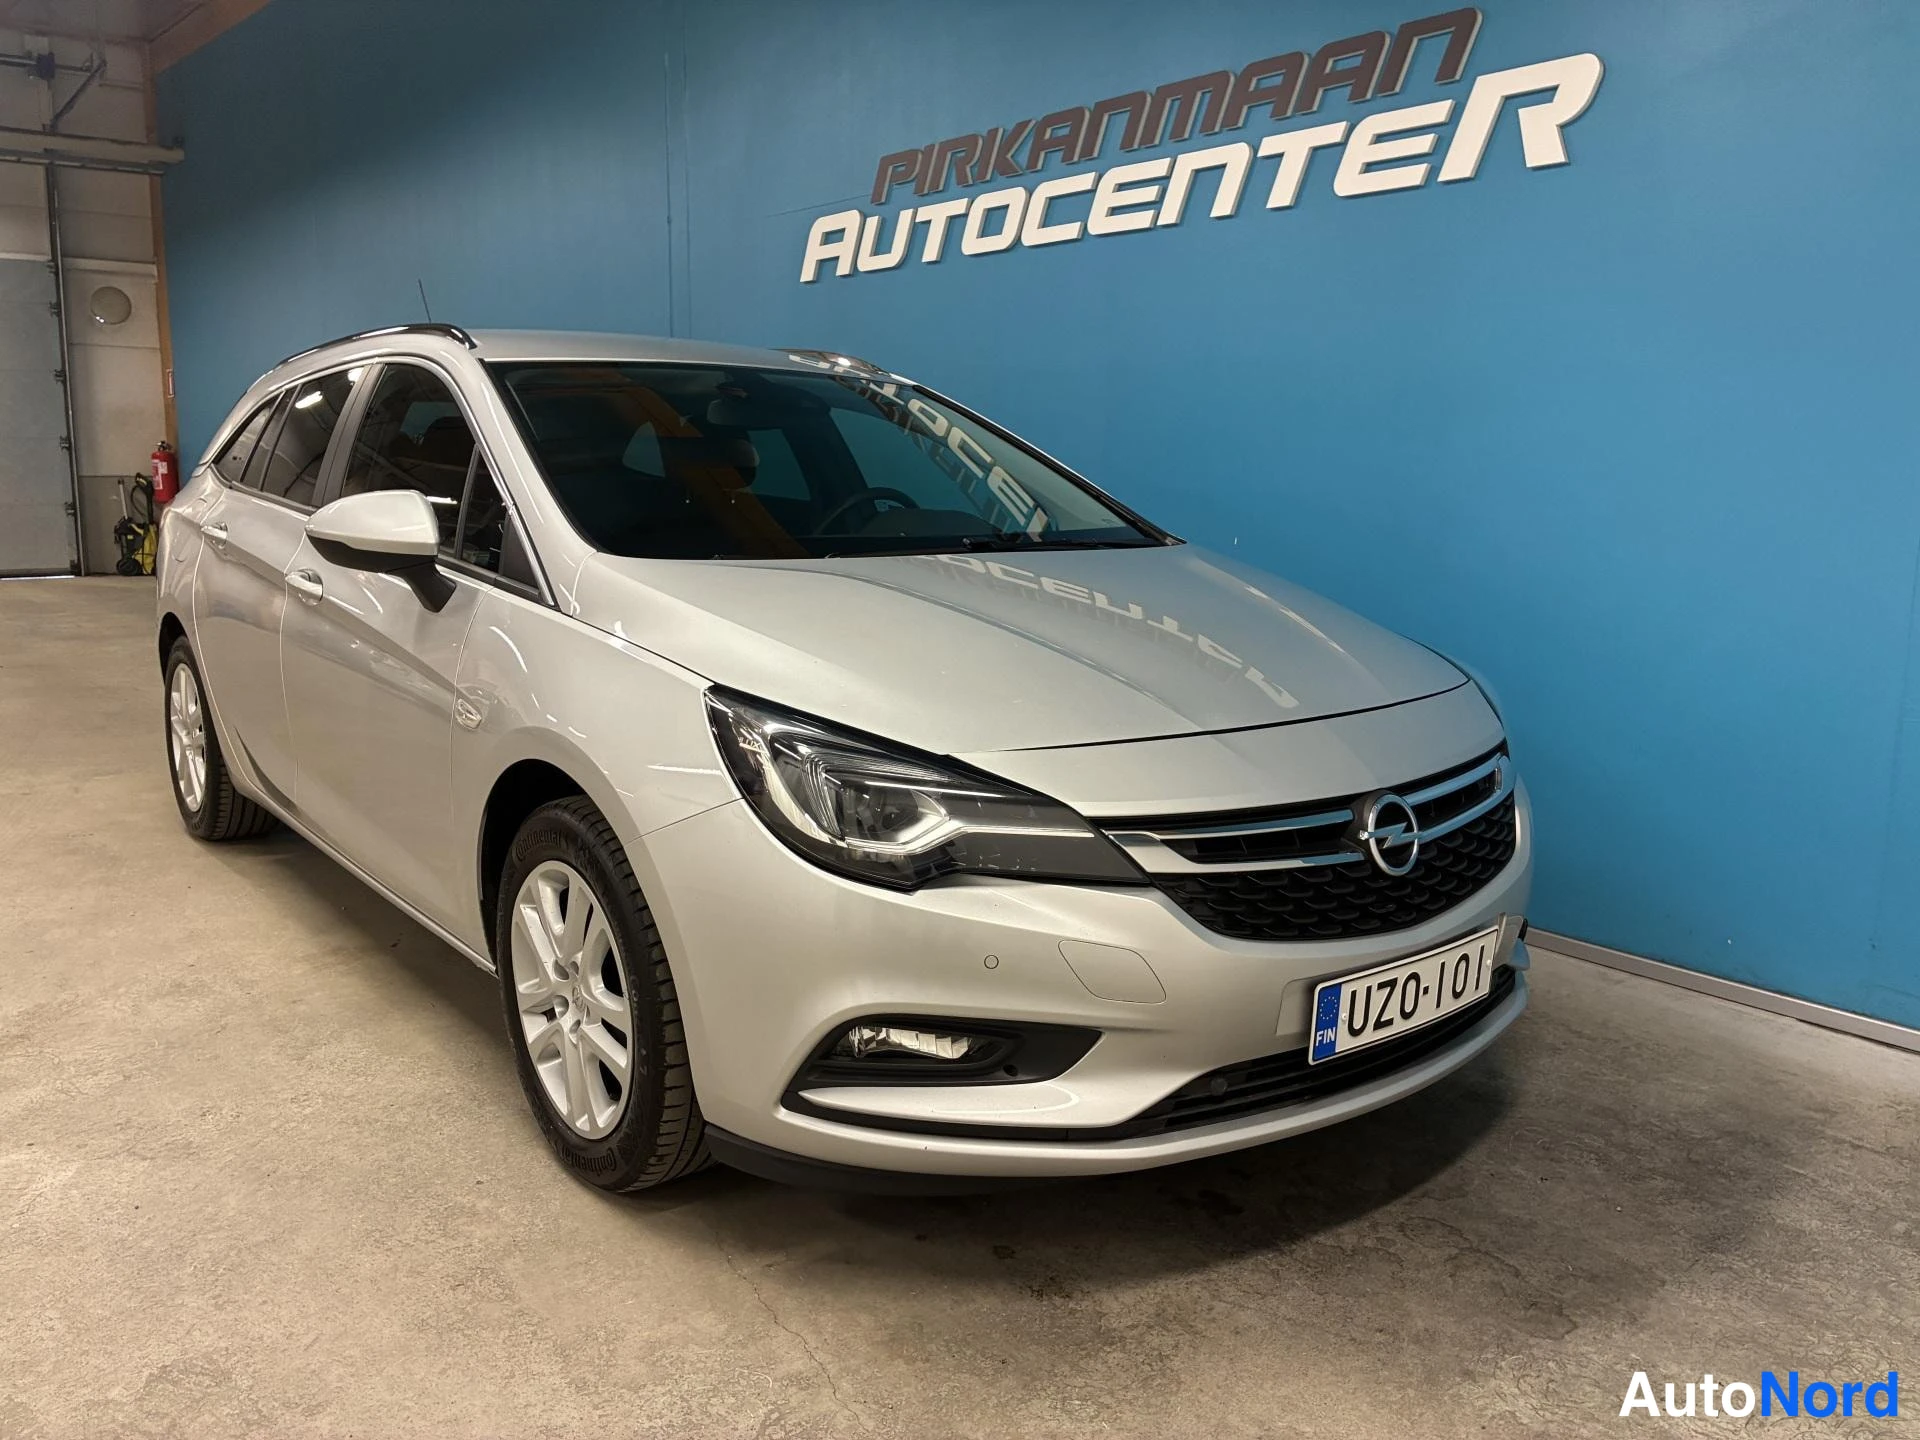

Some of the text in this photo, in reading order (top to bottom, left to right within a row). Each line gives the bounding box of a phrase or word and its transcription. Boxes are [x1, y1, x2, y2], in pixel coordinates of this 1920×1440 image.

[799, 52, 1604, 284] AUTOCENTER
[870, 7, 1483, 204] PIRKANMAAN
[1315, 1027, 1336, 1047] FIN
[1348, 945, 1485, 1037] UZO-101
